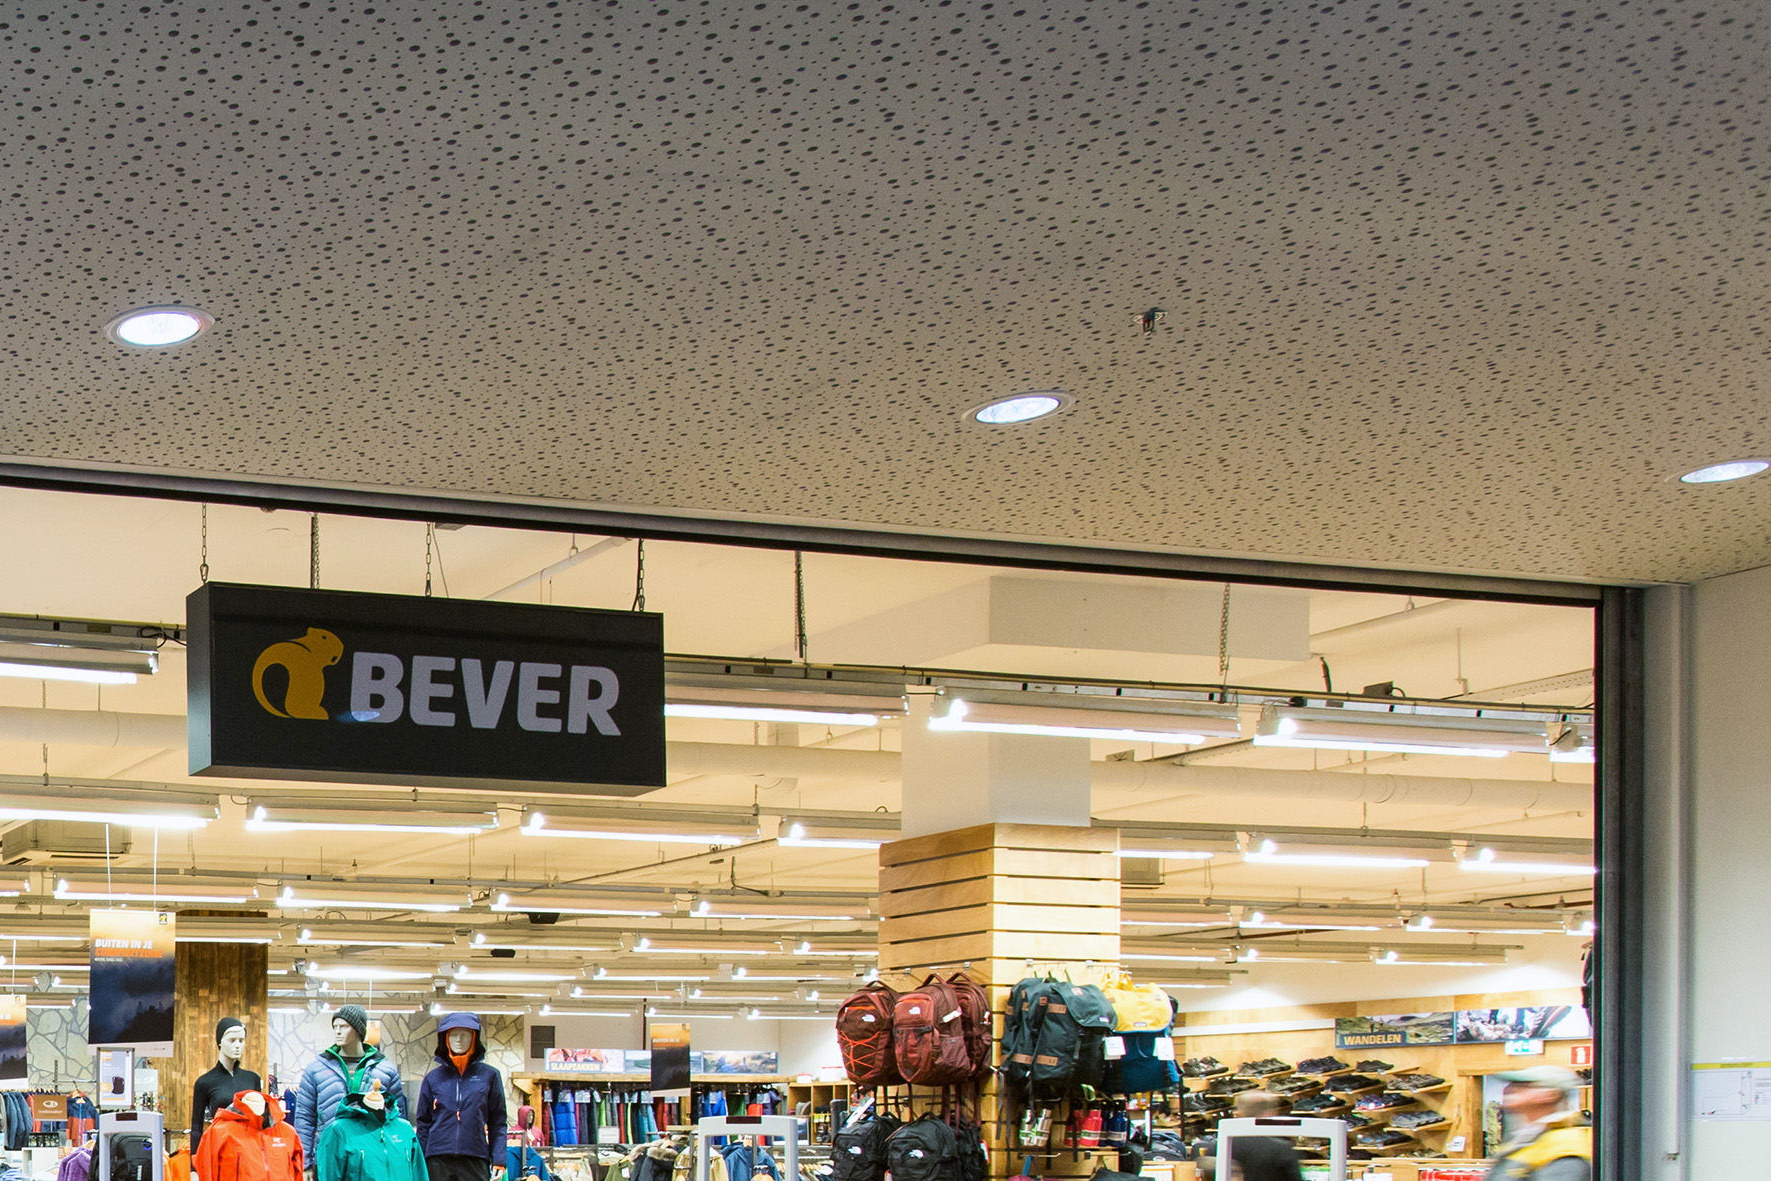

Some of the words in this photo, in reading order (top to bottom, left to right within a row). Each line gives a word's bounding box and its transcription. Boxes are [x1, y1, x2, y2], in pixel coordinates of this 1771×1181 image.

[350, 651, 622, 736] BEVER
[94, 938, 129, 948] BUITEN
[131, 939, 141, 949] IN
[142, 940, 153, 949] JE
[1343, 1034, 1402, 1045] WANDELEN
[550, 1063, 601, 1072] SLAAPZAKKEN
